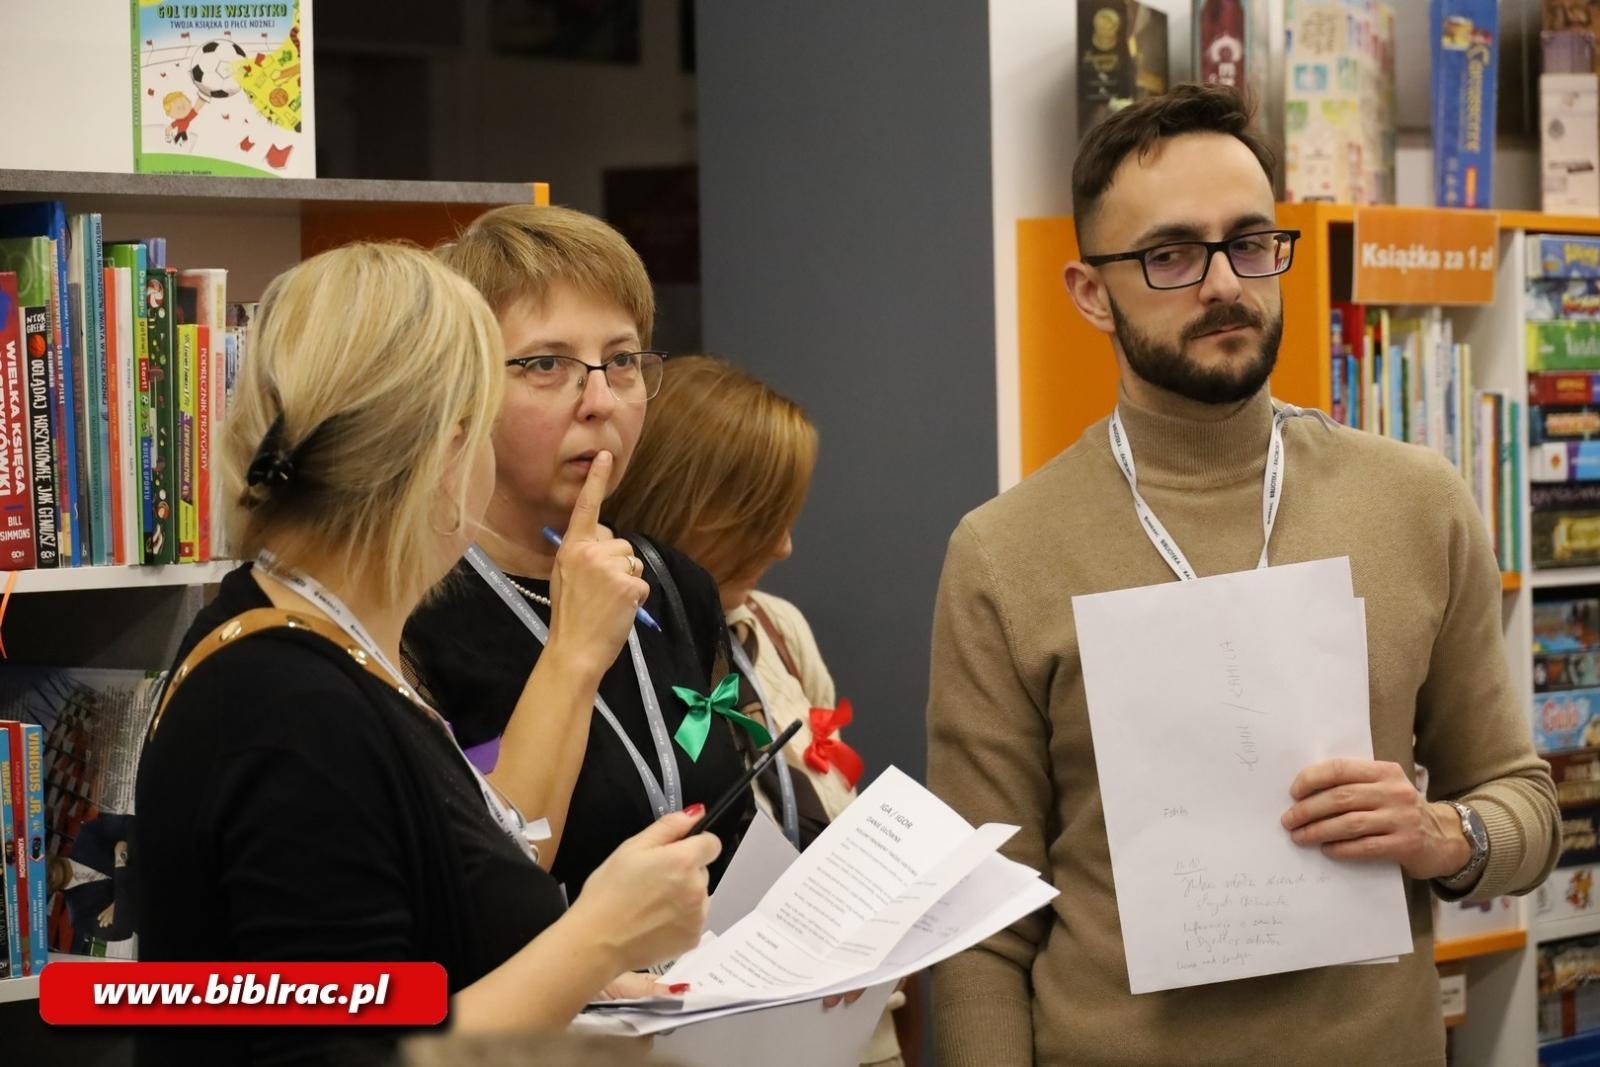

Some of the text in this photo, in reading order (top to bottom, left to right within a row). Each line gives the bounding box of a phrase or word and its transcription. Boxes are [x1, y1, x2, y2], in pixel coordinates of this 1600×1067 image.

[157, 3, 287, 19] GOL TO NIE WSZYSTKO
[170, 20, 193, 28] TWOJA
[1361, 243, 1441, 275] Książka
[1443, 249, 1464, 271] za
[1468, 246, 1477, 272] 1
[31, 359, 48, 409] OGLĄDAJ
[6, 339, 26, 495] WIELKA KSIĘGA
[200, 347, 209, 471] PODRĘCZNIK PRZYGODY
[33, 414, 52, 482] KOSZYKÓWKĘ
[37, 485, 53, 505] JAK
[0, 528, 31, 542] SIMMONS
[8, 516, 23, 527] BILL
[38, 507, 56, 548] GENIUSZ
[1160, 538, 1182, 566] BIBLIOTEKA
[28, 732, 41, 819] VINÍCIUS JR.
[880, 802, 893, 815] IGA
[895, 813, 914, 830] IGOR
